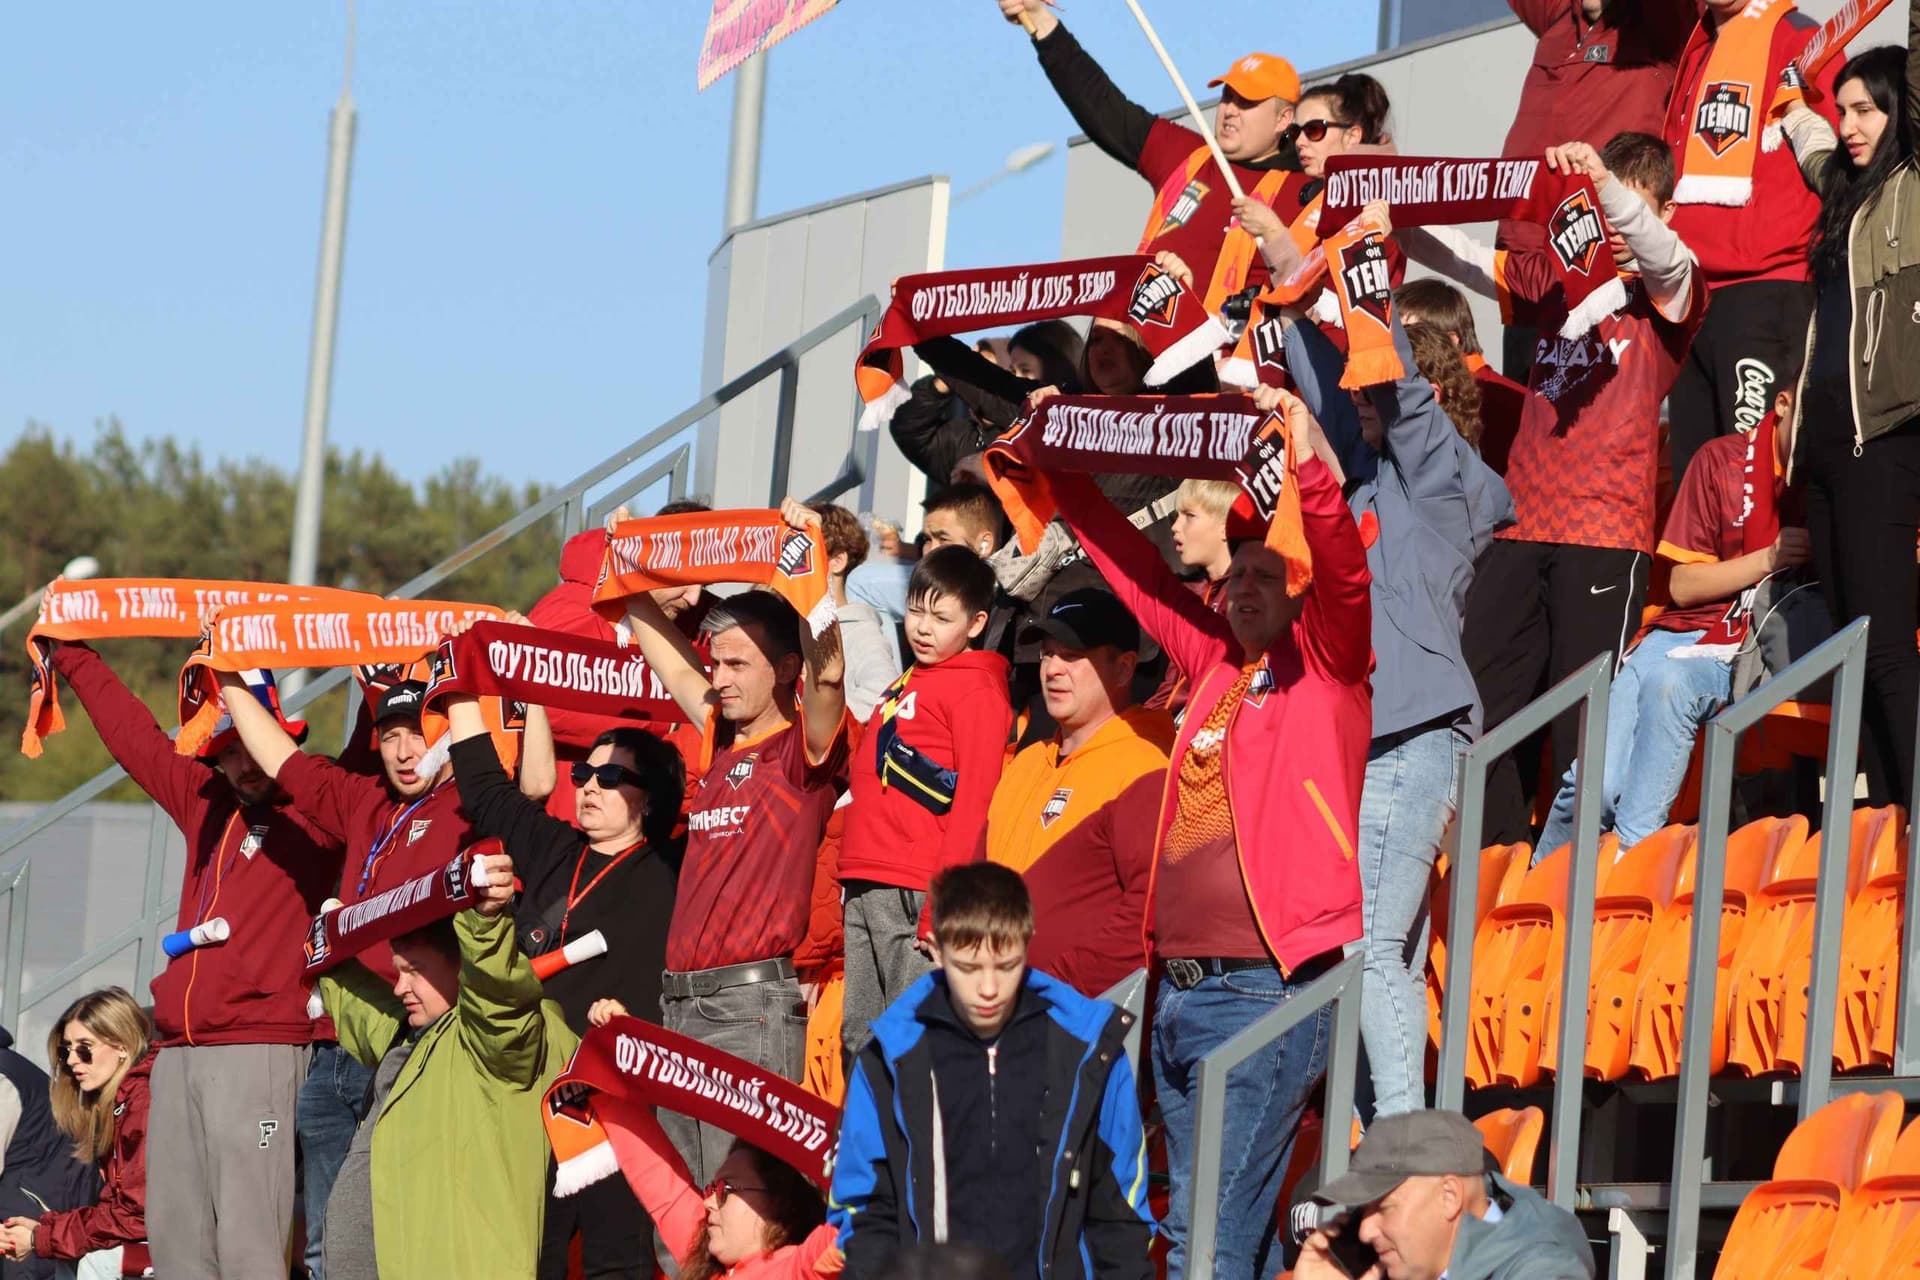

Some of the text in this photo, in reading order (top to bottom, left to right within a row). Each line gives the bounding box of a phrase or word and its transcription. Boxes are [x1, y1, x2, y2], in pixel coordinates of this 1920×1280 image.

[1699, 102, 1747, 133] ТЕМП
[1326, 160, 1540, 208] ФУТБОЛЬНЫЙ КЛУБ ТЕМП
[1556, 213, 1599, 259] ТЕМП
[911, 271, 1116, 322] ФУТБОЛЬНЫЙ КЛУБ ТЕМП
[1131, 274, 1177, 316] ТЕМП
[1346, 259, 1390, 299] ТЕМ
[1042, 404, 1260, 461] ФУТБОЛЬНЫЙ КЛУБ ТЕМП
[1252, 448, 1285, 506] ТЕМ
[648, 531, 682, 572] ТЕМП,
[688, 526, 737, 567] ТОЛЬКО
[741, 525, 779, 564] ТЕМП!
[778, 535, 809, 571] ТЕМП
[115, 587, 186, 622] ТЕМП,
[292, 613, 361, 652] ТЕМП,
[488, 640, 646, 698] ФУТБОЛЬНЫЙ
[387, 694, 413, 707] PUMA
[615, 1033, 828, 1151] ФУТБОЛЬНЫЙ КЛУБ
[259, 1120, 278, 1148] F
